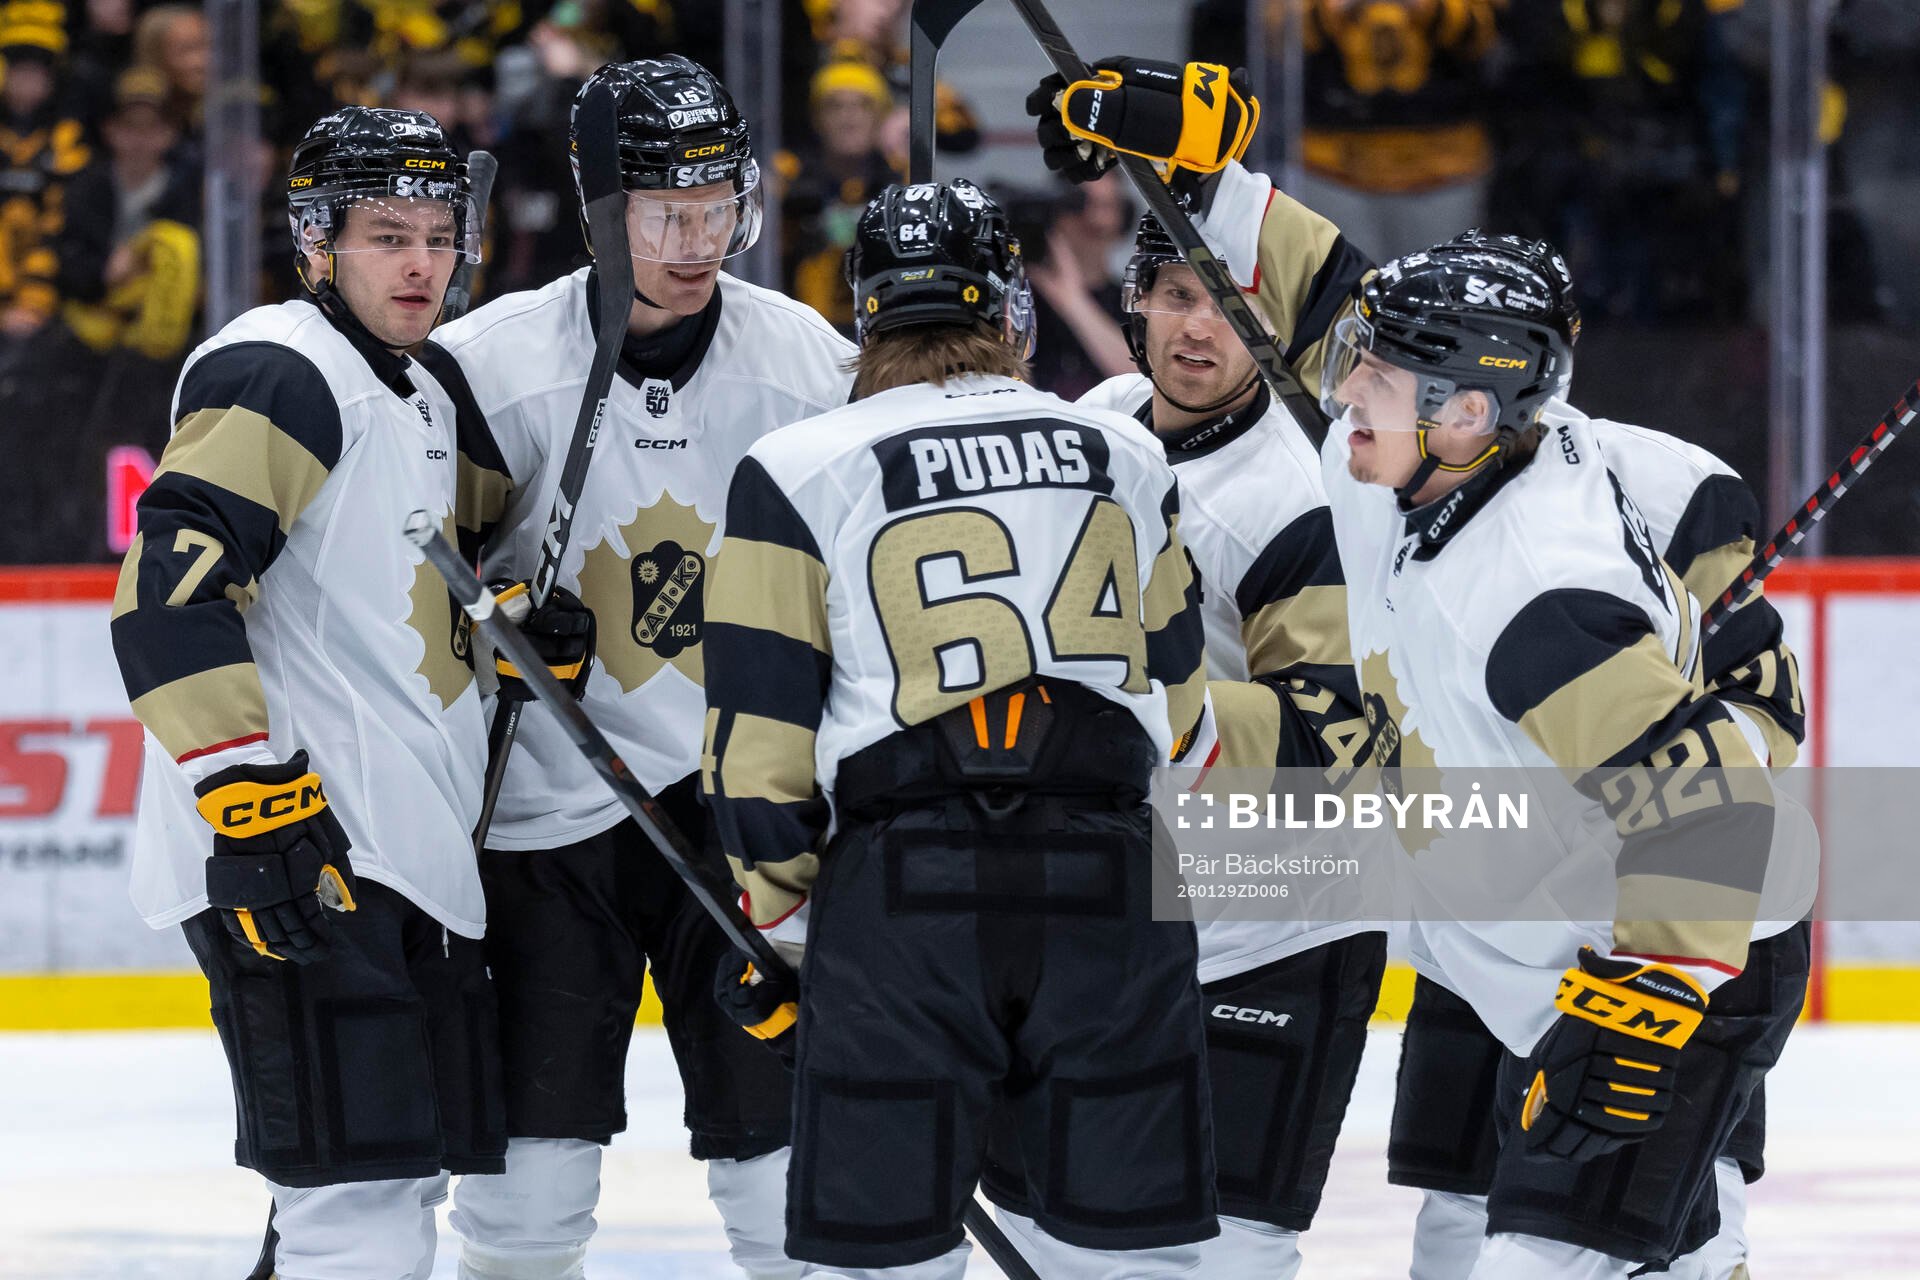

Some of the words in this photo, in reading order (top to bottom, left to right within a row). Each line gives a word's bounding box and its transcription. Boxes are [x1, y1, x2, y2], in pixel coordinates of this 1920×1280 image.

[674, 90, 701, 105] 15
[1088, 89, 1103, 132] CCM
[685, 144, 726, 159] CCM
[405, 158, 447, 170] CCM
[676, 164, 706, 188] SK
[290, 177, 313, 188] CCM
[395, 175, 427, 197] SK
[899, 222, 929, 242] 64
[1463, 275, 1506, 308] SK
[1478, 355, 1528, 370] CCM
[647, 385, 670, 397] SHL
[645, 396, 669, 415] 50
[588, 401, 606, 444] CCM
[1181, 414, 1234, 451] CCM
[426, 449, 448, 461] CCM
[634, 438, 688, 450] CCM
[1557, 425, 1580, 466] CCM
[908, 429, 1091, 500] PUDAS
[1427, 490, 1464, 540] CCM
[165, 528, 224, 607] 7
[867, 494, 1153, 730] 64
[669, 623, 696, 638] 1921
[1600, 727, 1725, 837] 22
[222, 782, 327, 829] CCM
[1210, 1003, 1294, 1028] CCM
